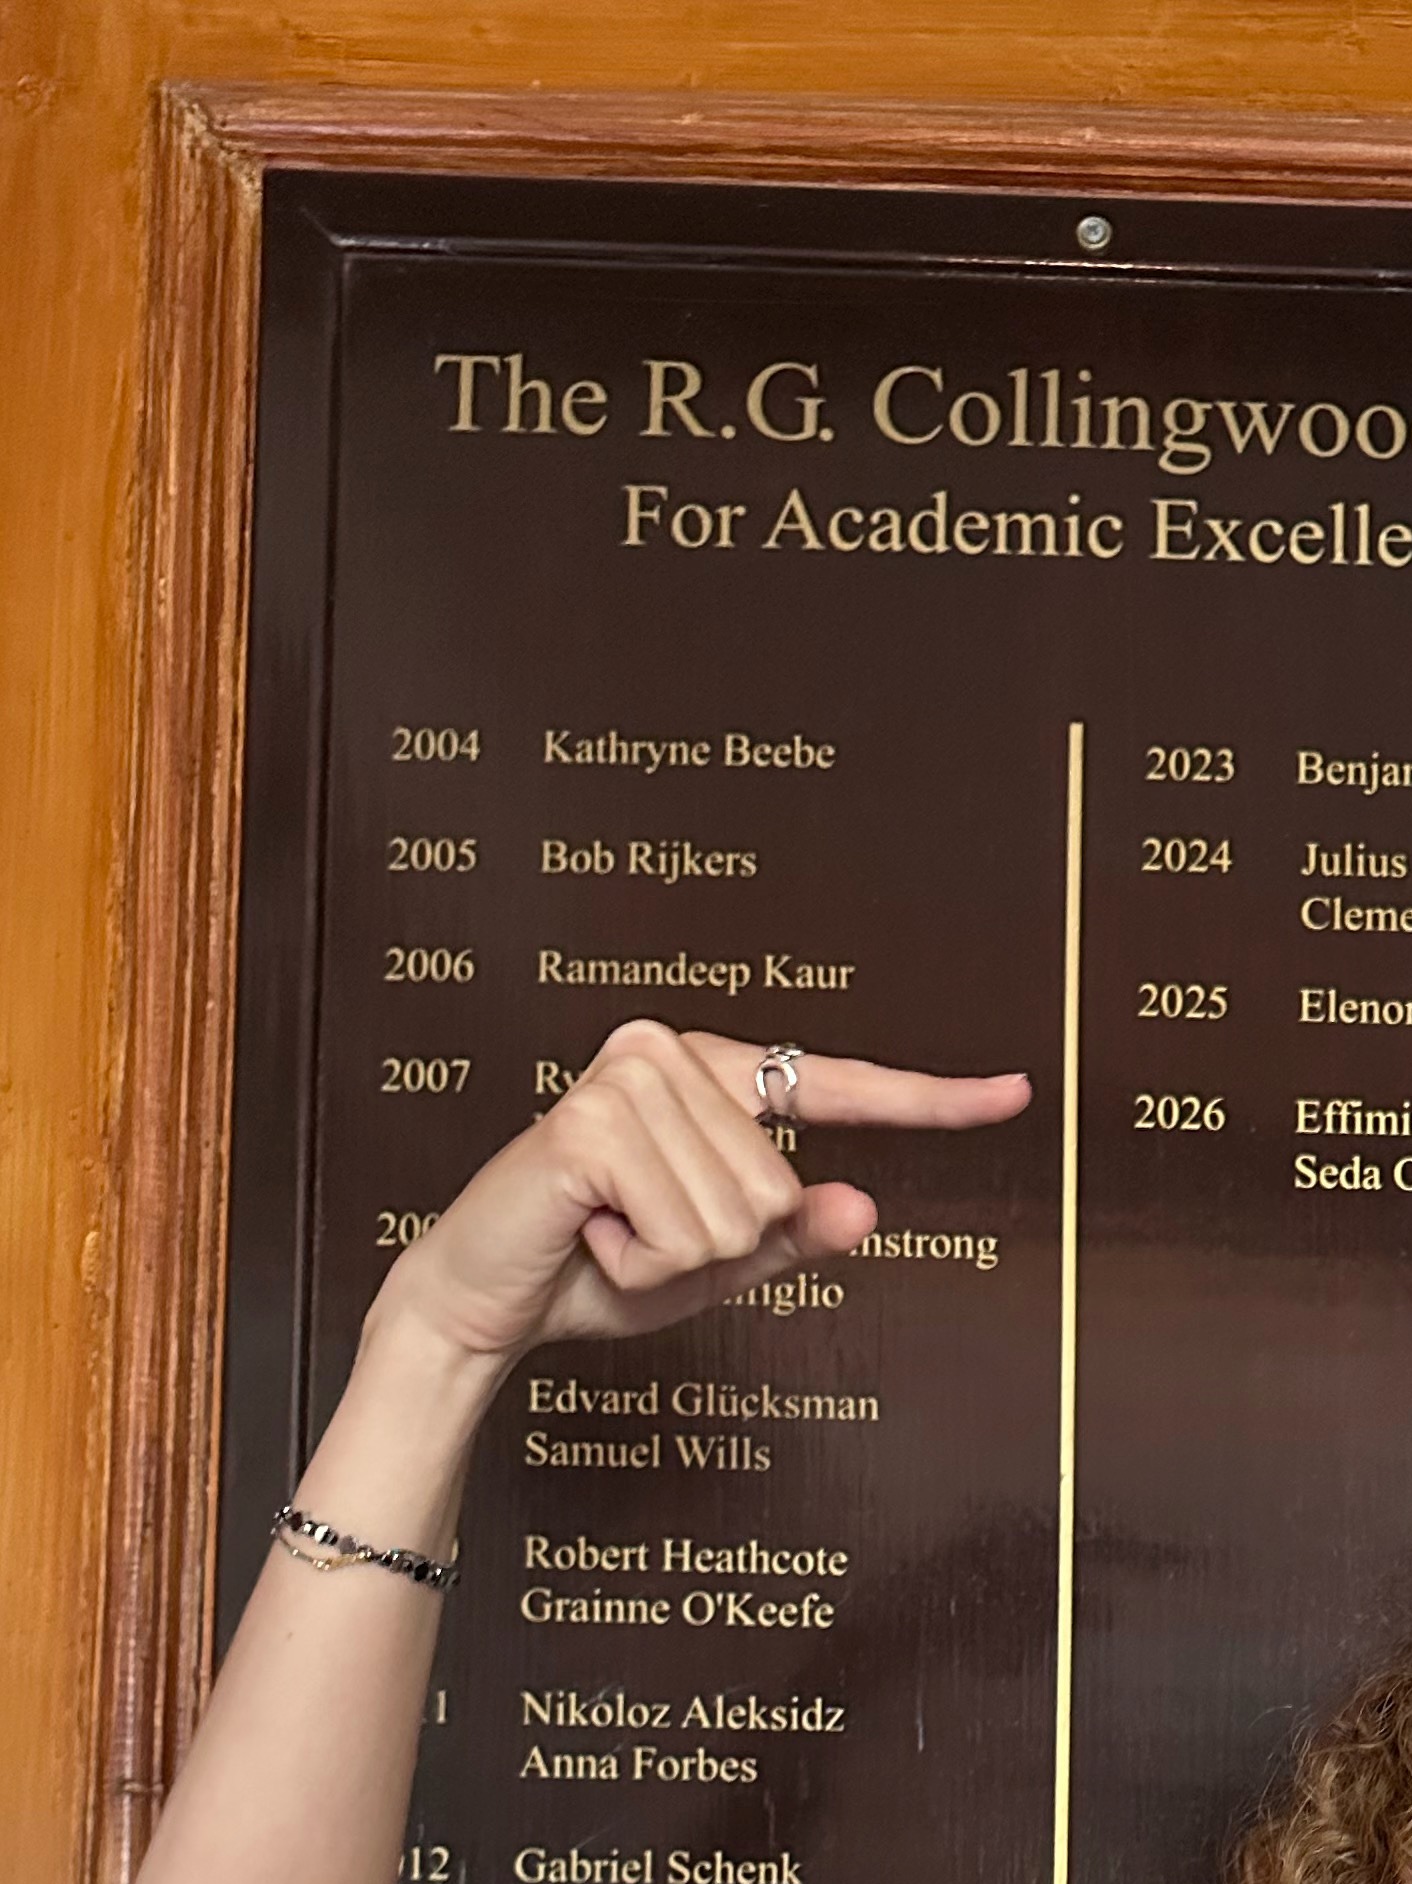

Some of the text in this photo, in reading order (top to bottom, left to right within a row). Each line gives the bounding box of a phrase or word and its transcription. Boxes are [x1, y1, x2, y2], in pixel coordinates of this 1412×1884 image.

[434, 353, 607, 436] The
[639, 360, 834, 442] R.G.
[624, 485, 746, 548] For
[762, 489, 1123, 559] Academic
[392, 727, 835, 774] 2004 Kathryne Beebe
[1146, 746, 1235, 782] 2023
[388, 837, 757, 884] 2005 Bob Rijkers
[1142, 837, 1232, 873] 2024
[1301, 843, 1407, 878] Julius
[384, 947, 855, 996] 2006 Ramandeep Kaur
[1138, 983, 1228, 1020] 2025
[381, 1057, 471, 1092] 2007
[1134, 1094, 1226, 1131] 2026
[1294, 1154, 1382, 1191] Seda
[529, 1379, 879, 1421] Edvard Glücksman
[525, 1431, 771, 1471] Samuel Wills
[526, 1535, 848, 1577] Robert Heathcote
[520, 1588, 834, 1628] Grainne O'Keefe
[521, 1690, 844, 1732] Nikoloz Aleksidz
[520, 1745, 758, 1782] Anna Forbes
[398, 1845, 450, 1882] 12
[514, 1848, 652, 1884] Gabriel
